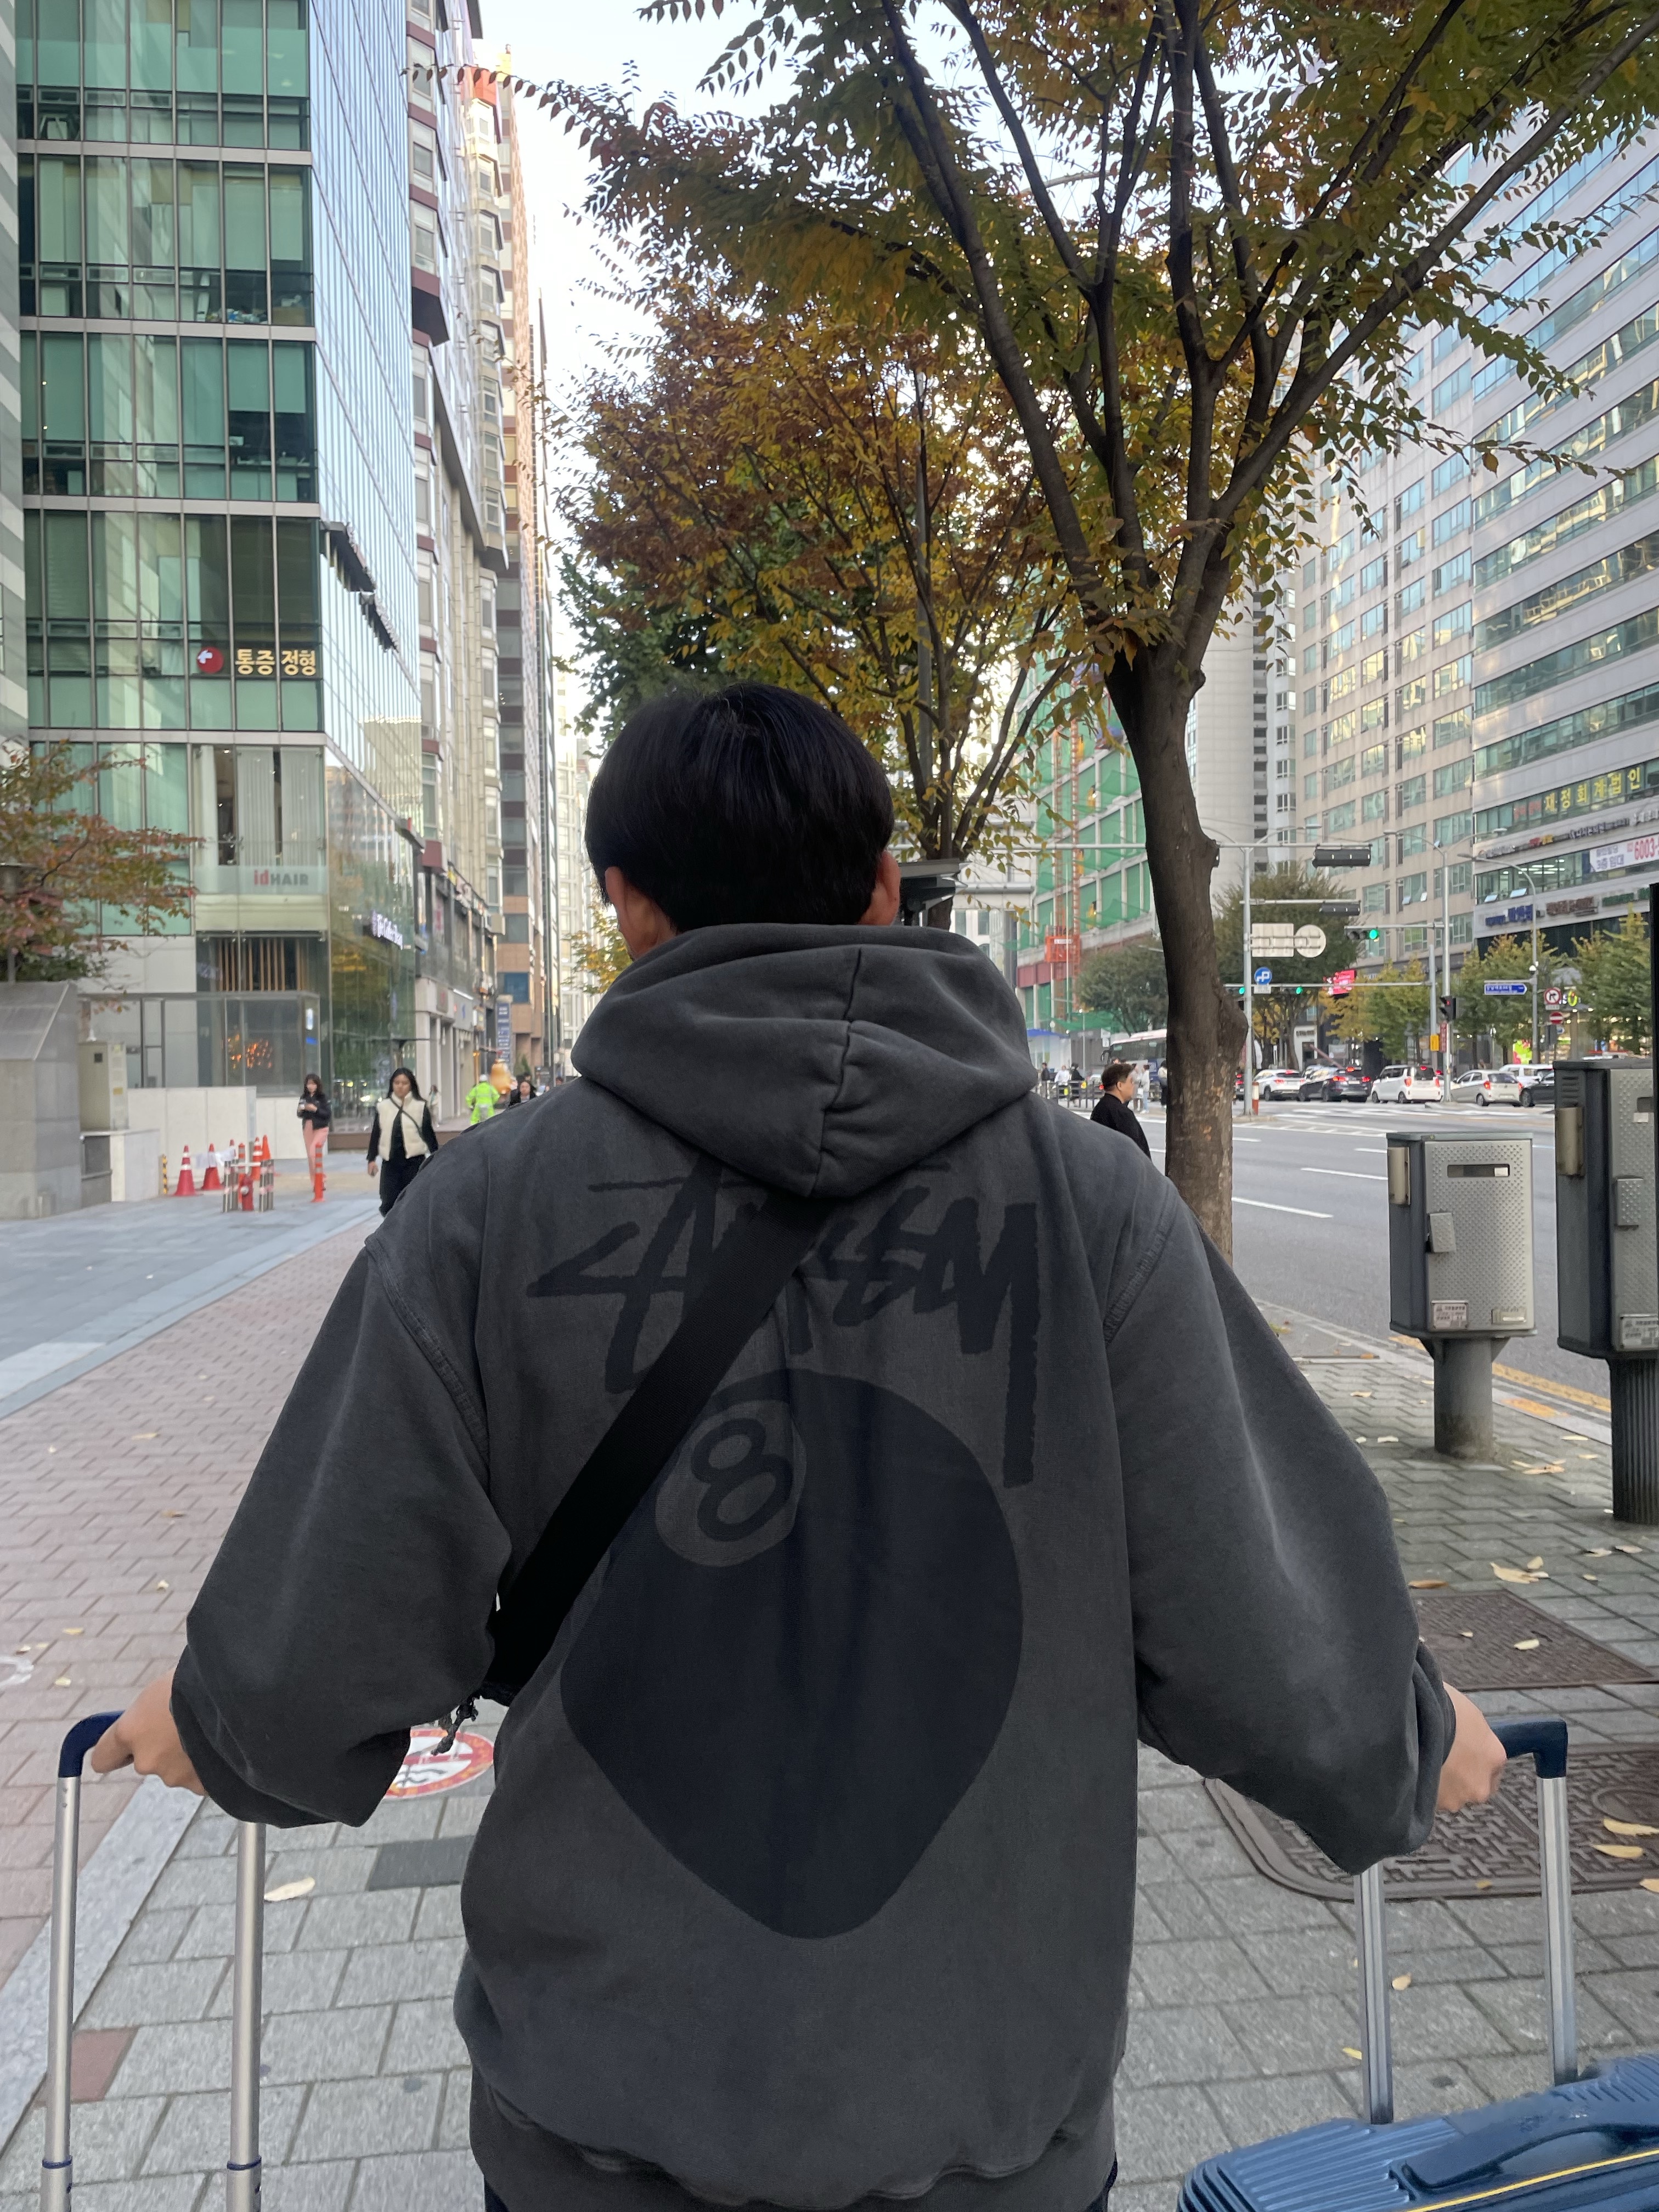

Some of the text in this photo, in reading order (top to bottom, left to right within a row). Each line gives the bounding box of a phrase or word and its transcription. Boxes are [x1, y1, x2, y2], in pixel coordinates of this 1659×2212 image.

[235, 648, 317, 676] 통증 정형
[1634, 836, 1659, 860] 6003-
